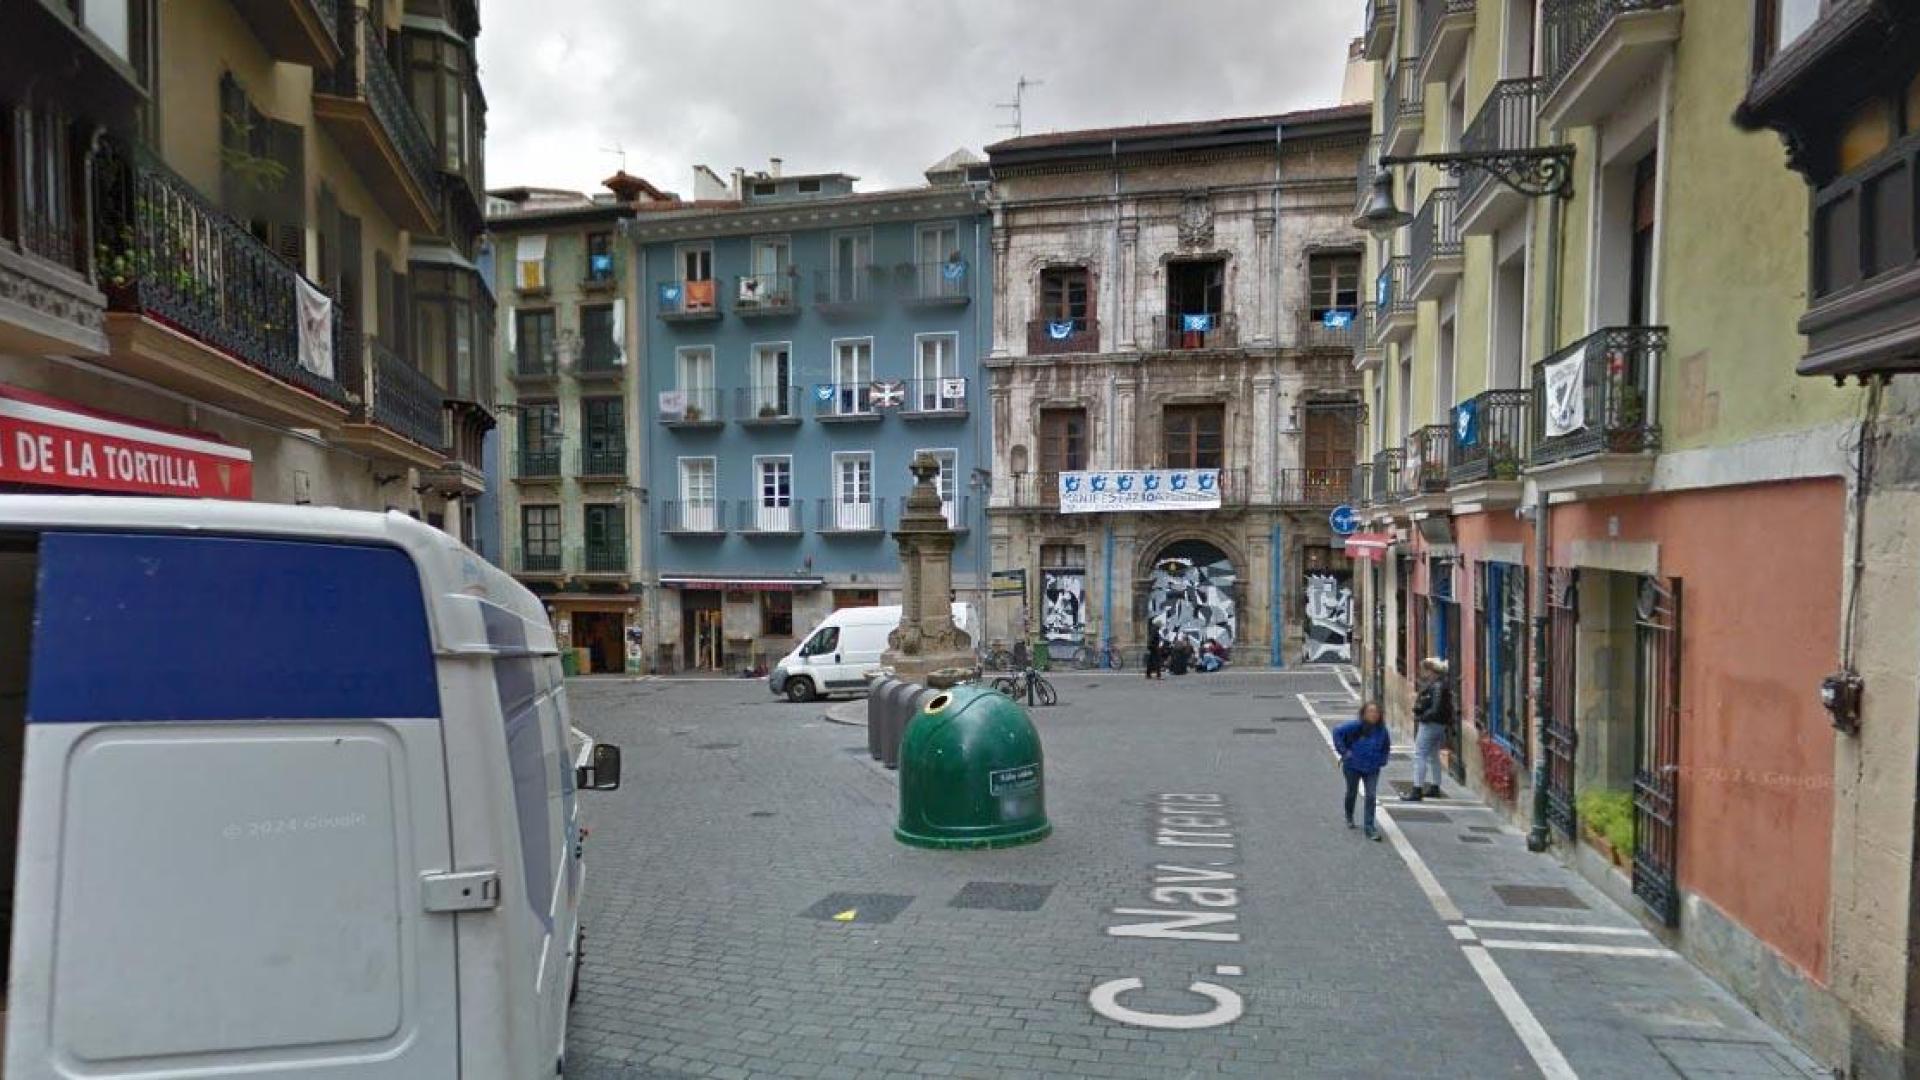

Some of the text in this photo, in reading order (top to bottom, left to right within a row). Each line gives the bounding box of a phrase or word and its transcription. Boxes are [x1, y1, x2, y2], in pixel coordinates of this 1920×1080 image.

[16, 431, 55, 473] DE
[64, 440, 97, 478] LA
[103, 445, 199, 489] TORTILLA
